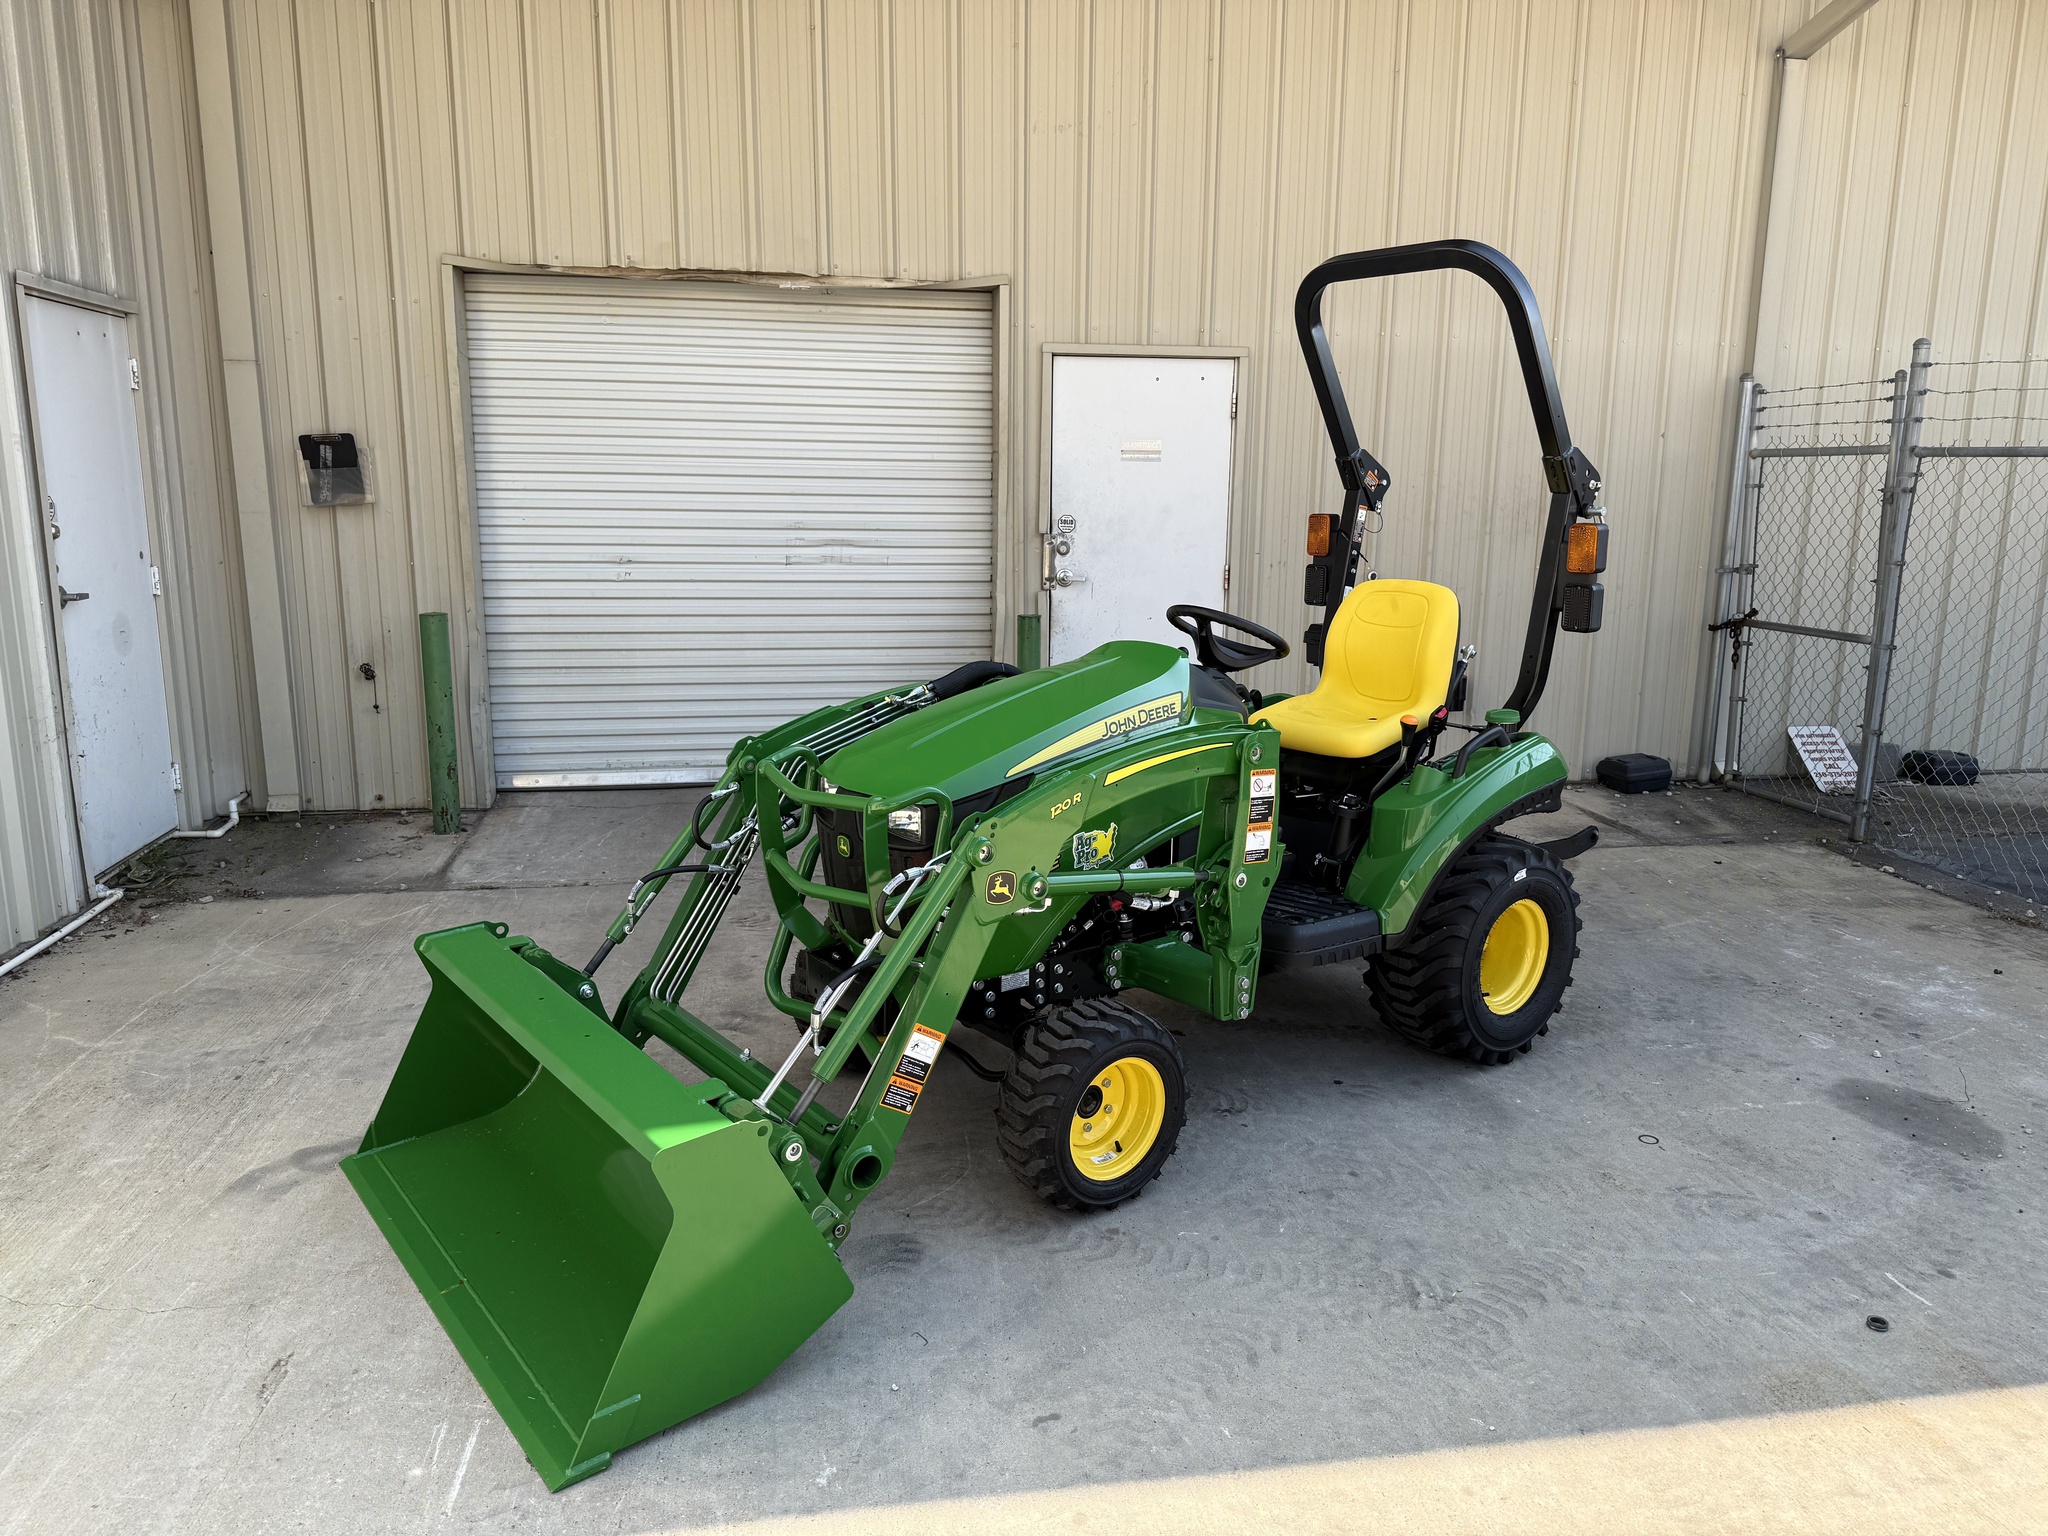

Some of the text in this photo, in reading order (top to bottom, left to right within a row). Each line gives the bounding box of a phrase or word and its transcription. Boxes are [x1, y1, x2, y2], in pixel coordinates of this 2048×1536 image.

[1102, 702, 1178, 738] JOHN DEERE
[1076, 834, 1097, 851] Ag-
[1076, 848, 1098, 864] Pro
[922, 1028, 942, 1040] WARNING
[898, 1081, 919, 1091] WARNING
